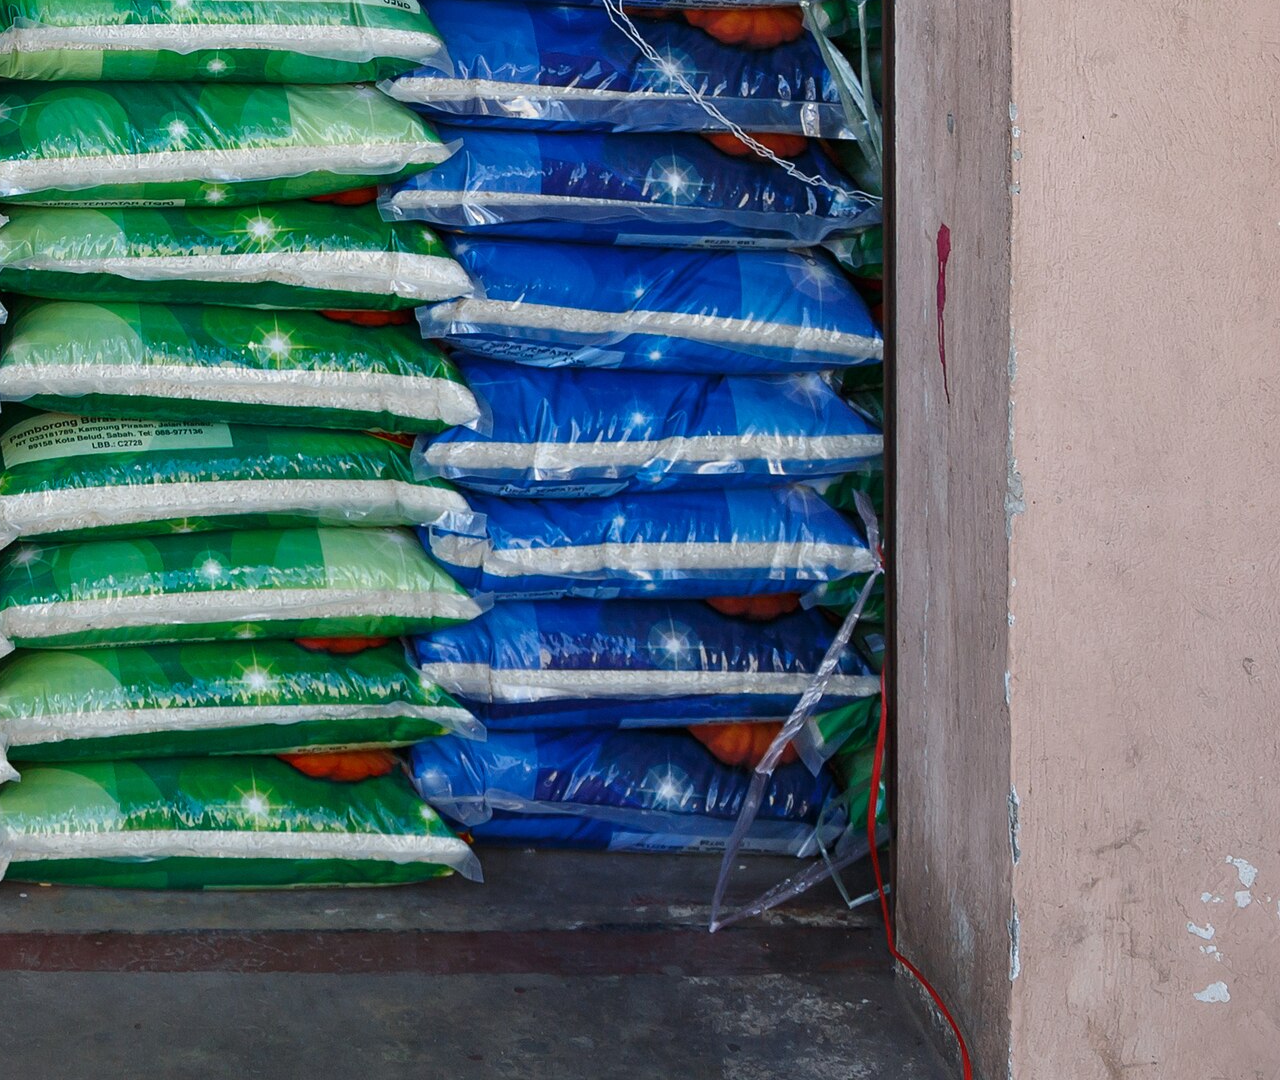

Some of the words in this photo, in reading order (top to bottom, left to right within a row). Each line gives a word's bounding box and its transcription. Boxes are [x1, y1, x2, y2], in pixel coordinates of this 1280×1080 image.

[9, 418, 78, 444] Pemborong
[78, 424, 120, 434] Kampung
[121, 422, 157, 430] Pirasan,
[28, 441, 53, 451] 89158
[55, 436, 76, 445] Kota
[77, 433, 105, 442] Belud,
[154, 428, 203, 436] 088-977136
[92, 442, 116, 450] LBB.:
[117, 439, 143, 448] C2728
